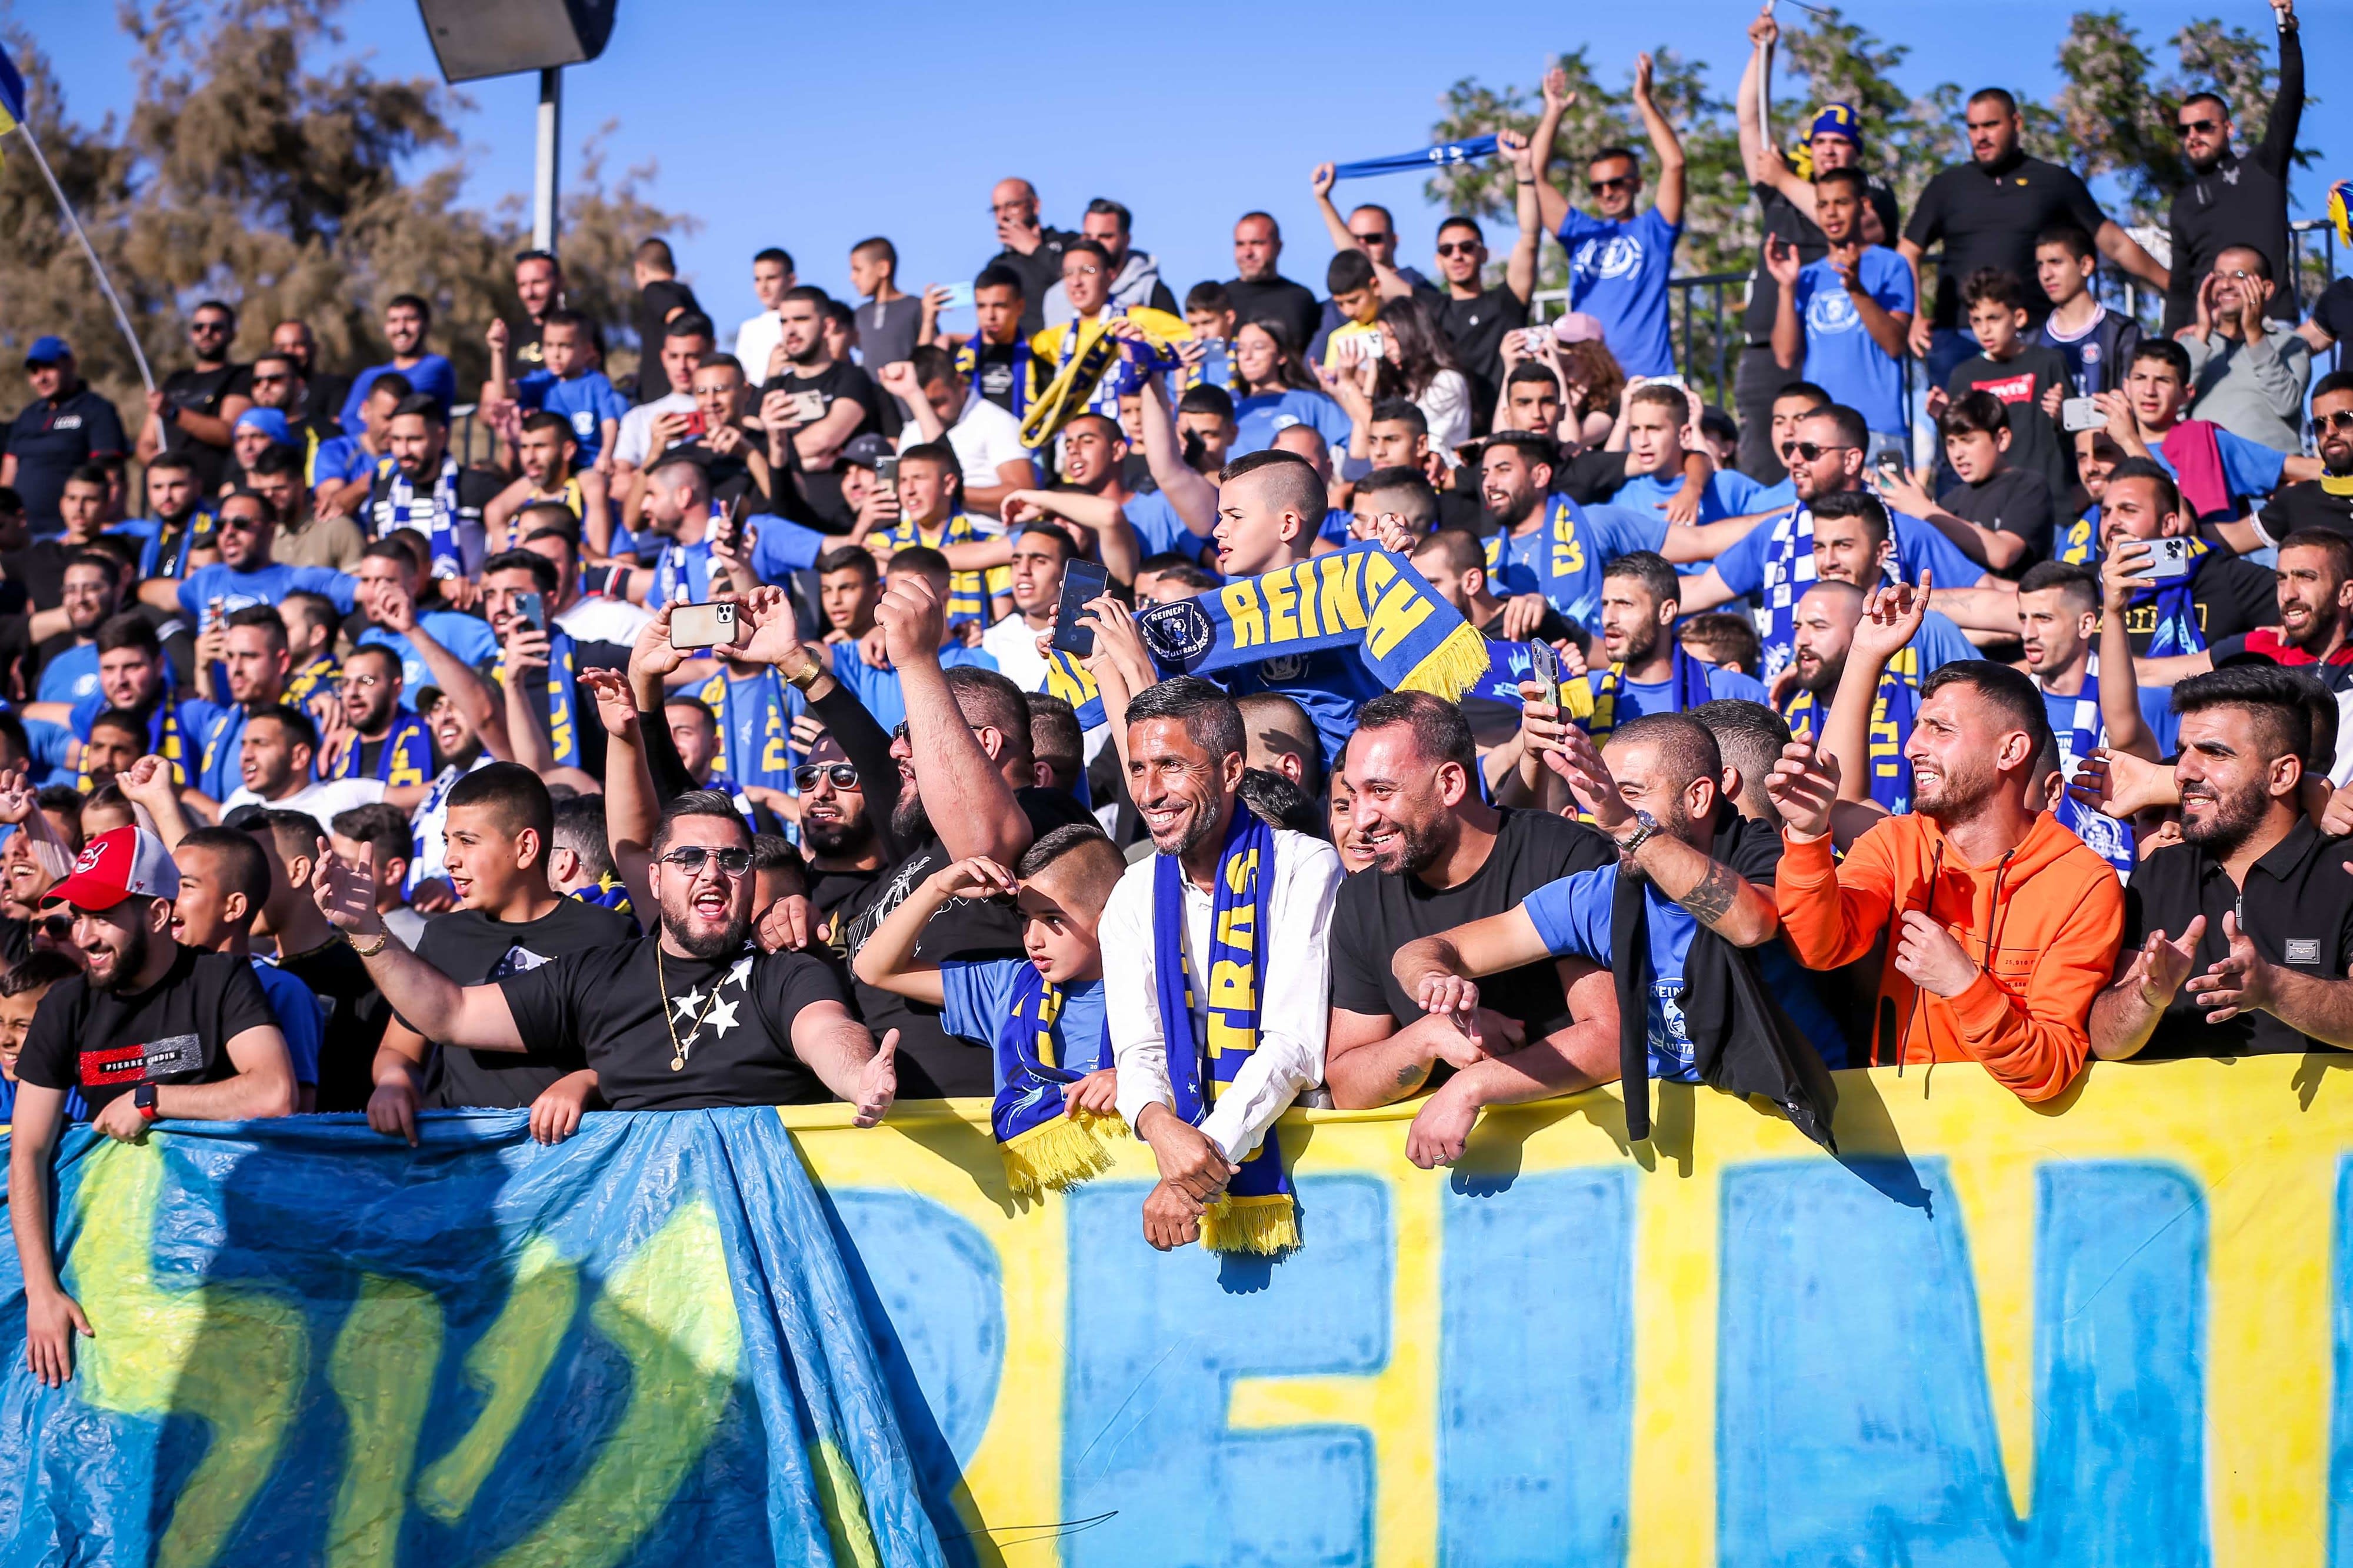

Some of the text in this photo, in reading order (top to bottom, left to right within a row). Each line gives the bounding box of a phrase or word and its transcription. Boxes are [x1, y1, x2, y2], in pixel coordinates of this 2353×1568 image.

[1151, 605, 1185, 622] REINEH
[1171, 644, 1198, 657] ULTRAS
[106, 1059, 144, 1071] PIERRE
